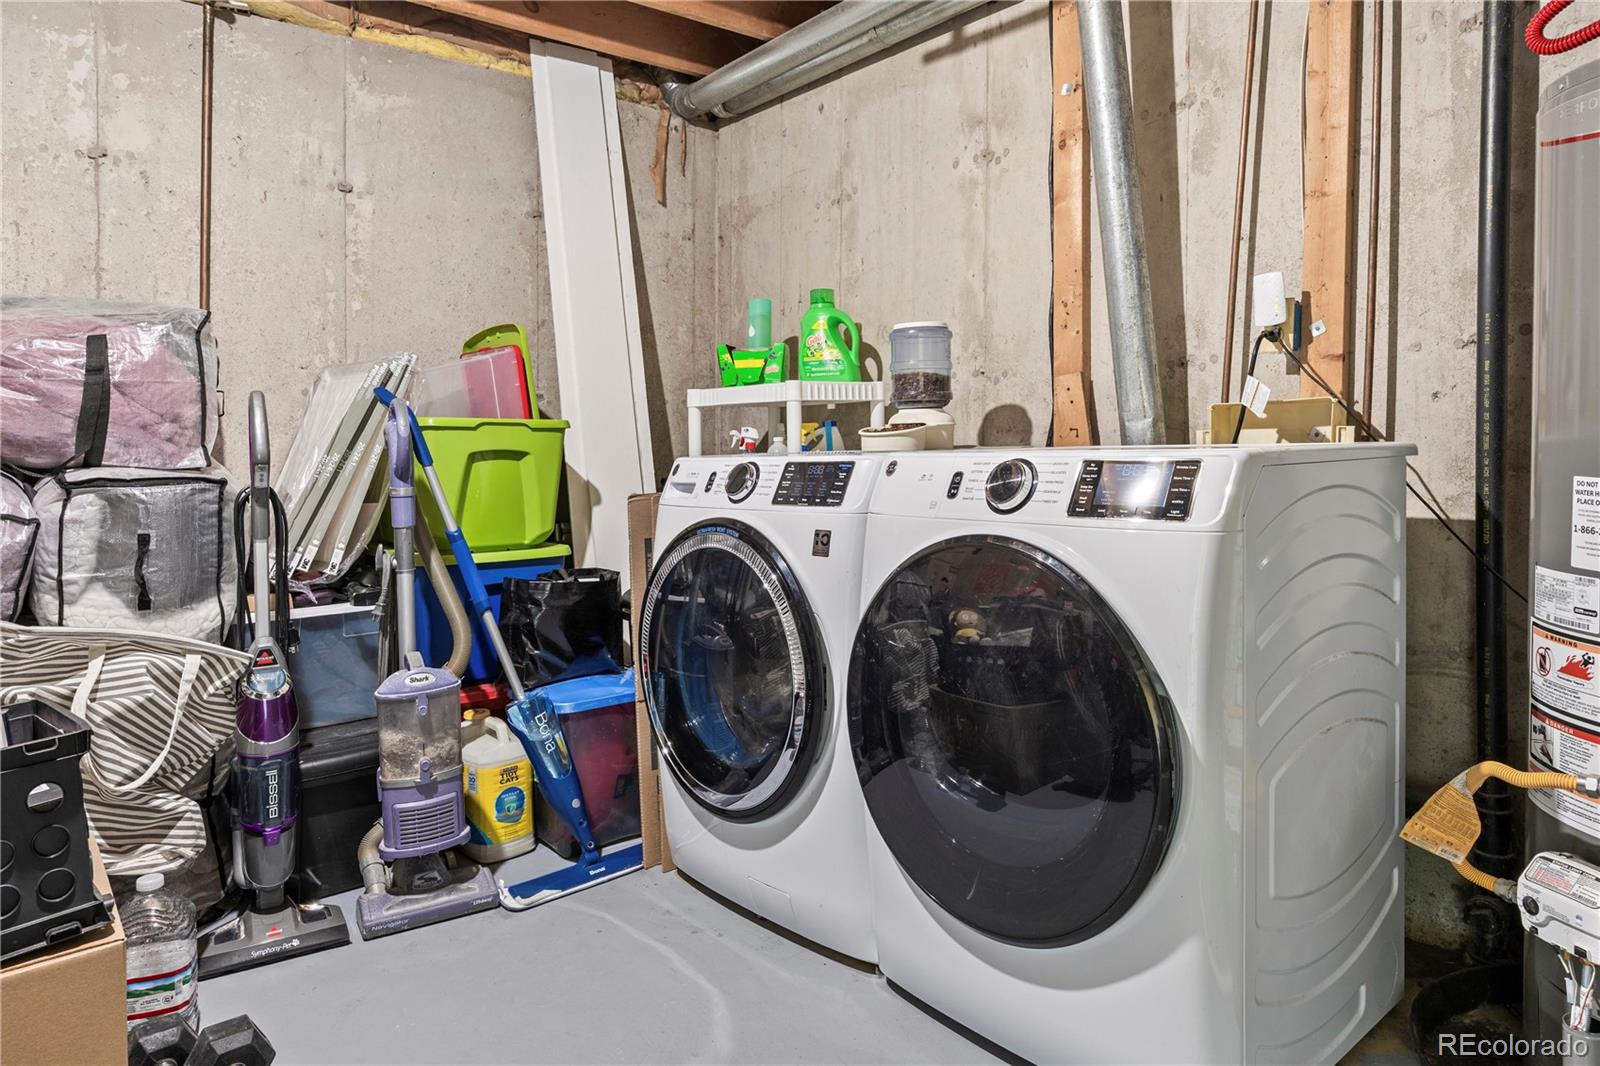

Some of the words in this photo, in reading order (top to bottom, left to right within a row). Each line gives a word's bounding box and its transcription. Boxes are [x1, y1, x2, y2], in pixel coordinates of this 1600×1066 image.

[1550, 634, 1578, 648] WARNING
[409, 676, 430, 684] Shark
[534, 711, 556, 753] Bona
[500, 770, 518, 779] TIDY
[500, 776, 520, 784] CATS
